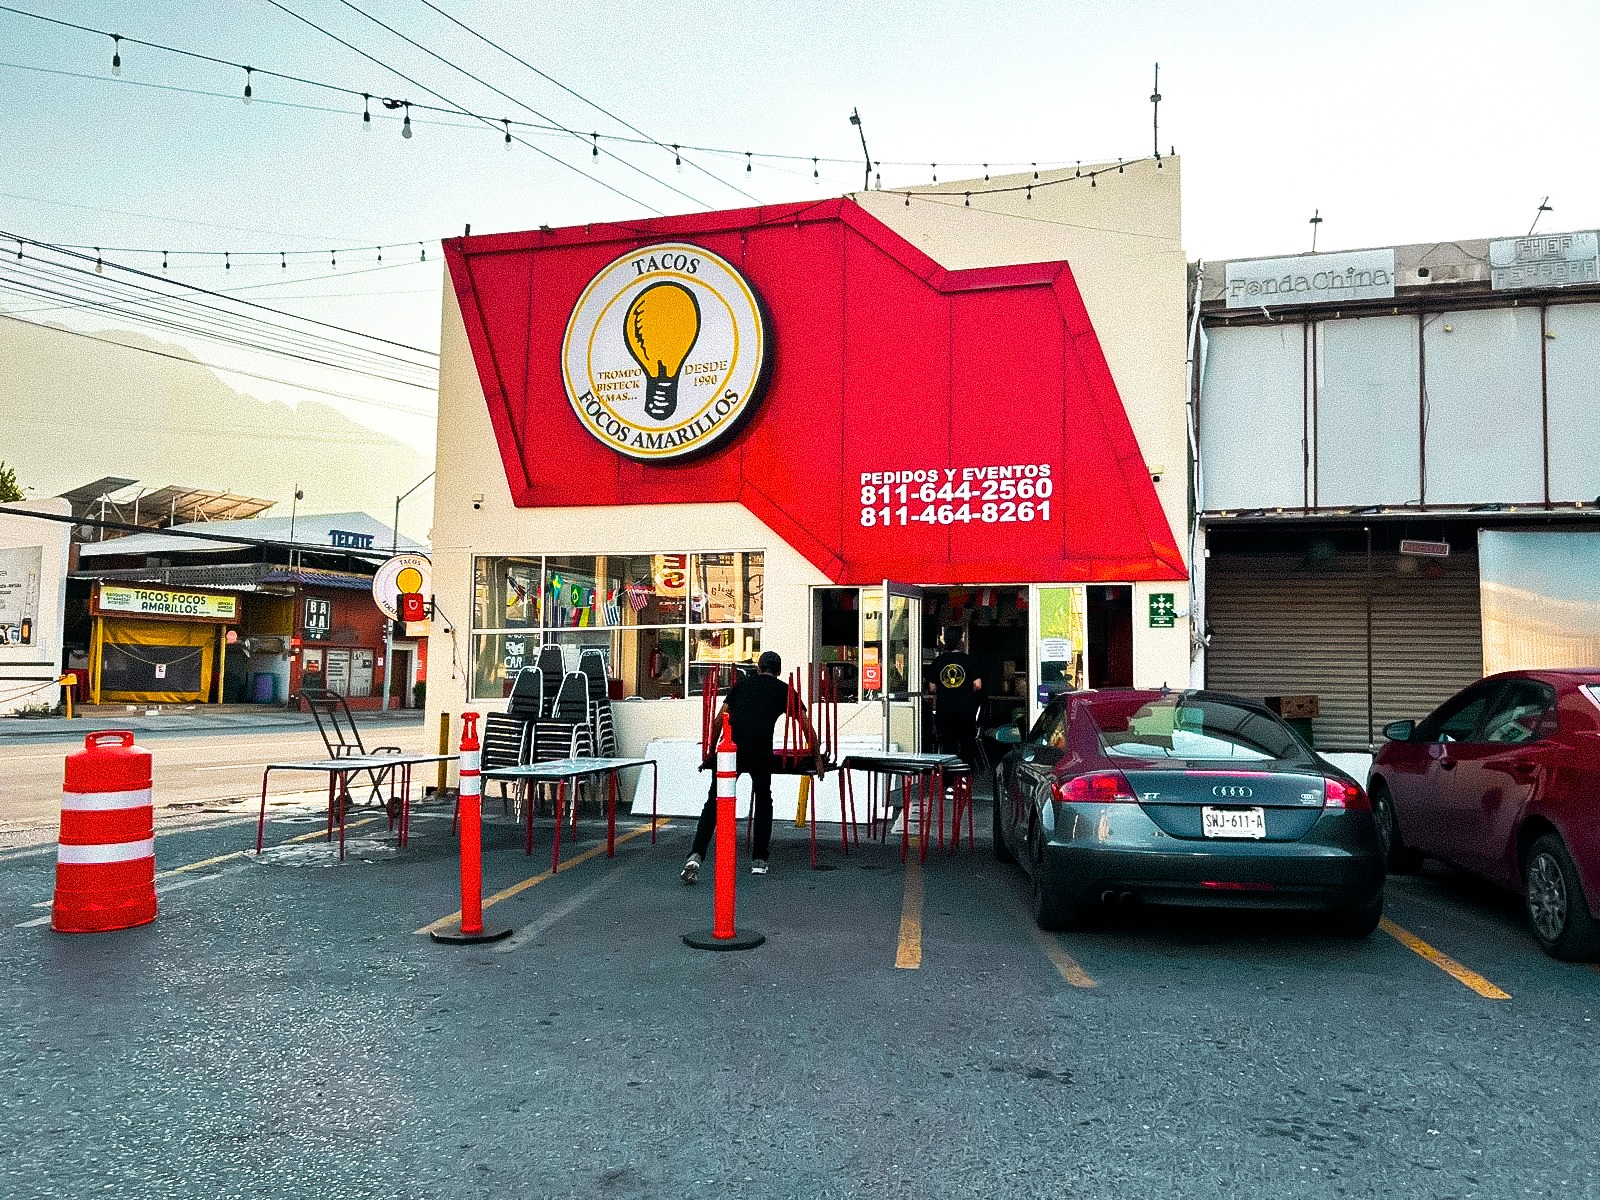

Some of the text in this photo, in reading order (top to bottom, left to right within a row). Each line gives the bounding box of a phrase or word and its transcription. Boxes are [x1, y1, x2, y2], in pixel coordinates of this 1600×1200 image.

[632, 253, 700, 276] TACOS
[597, 368, 642, 380] TROMPO
[684, 360, 728, 376] DESDE
[596, 380, 641, 392] BISTECK
[693, 375, 718, 387] 1990
[578, 389, 739, 449] FOCOS AMARILLOS
[861, 464, 1050, 485] PEDIDOS Y EVENTOS
[860, 478, 1053, 505] 811-644-2560
[860, 500, 1050, 527] 811-464-8261
[399, 558, 421, 566] TACOS
[134, 590, 169, 602] TACOS
[172, 594, 206, 605] FOCOS
[141, 602, 198, 614] AMARILLOS
[1205, 813, 1263, 828] SWJ-611-A
